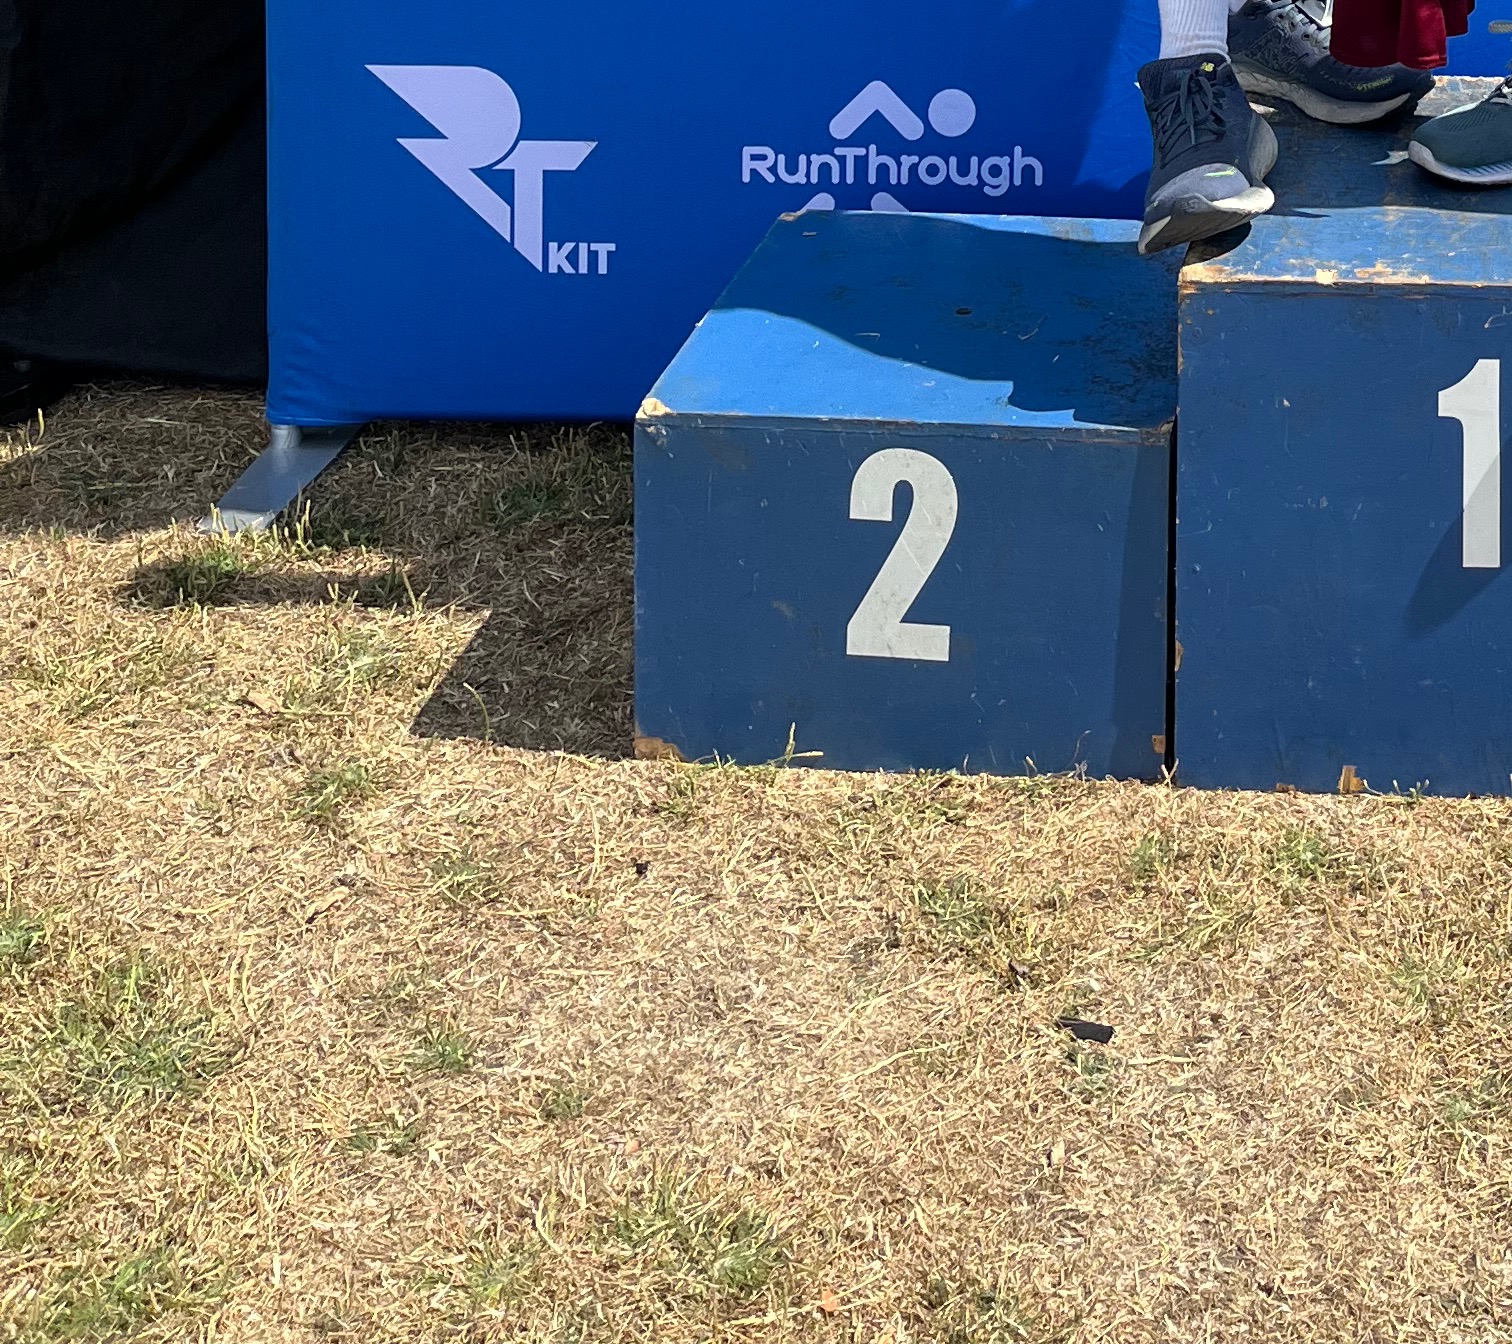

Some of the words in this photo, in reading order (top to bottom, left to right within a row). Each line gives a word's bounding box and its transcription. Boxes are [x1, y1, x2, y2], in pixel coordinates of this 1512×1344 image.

[742, 144, 1042, 197] RunThrough
[549, 242, 615, 274] KIT
[1437, 359, 1501, 568] 1
[846, 447, 959, 662] 2
